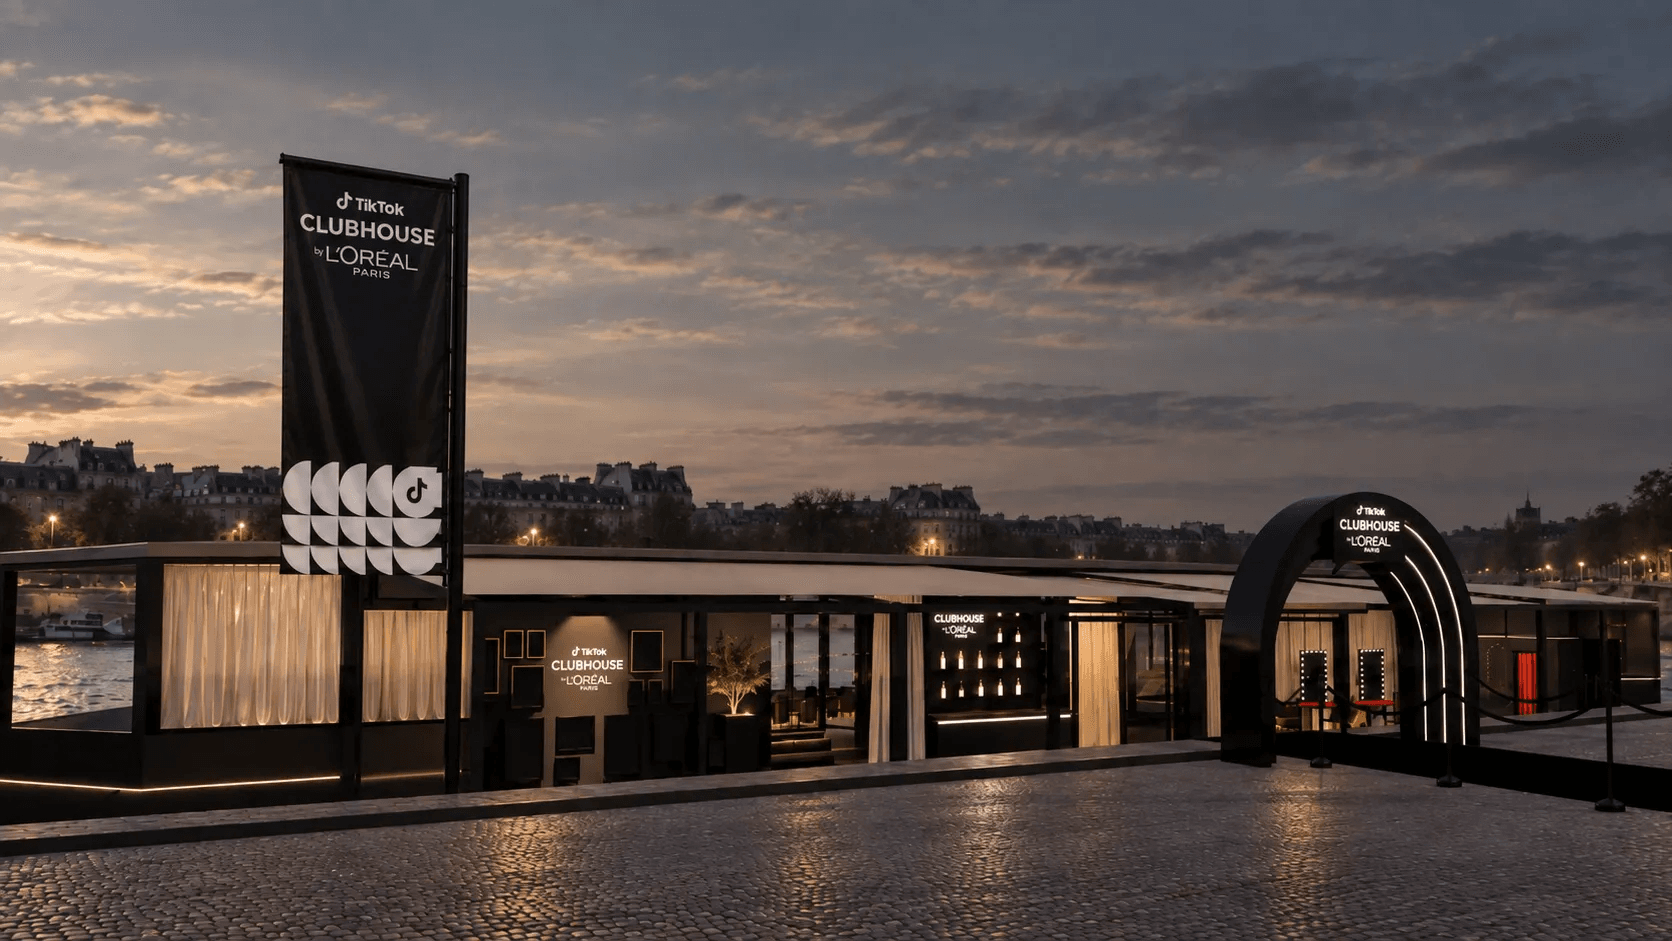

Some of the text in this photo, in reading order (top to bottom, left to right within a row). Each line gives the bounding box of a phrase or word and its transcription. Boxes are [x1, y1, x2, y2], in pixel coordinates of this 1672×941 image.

[355, 197, 404, 216] TikTok
[300, 213, 435, 246] CLUBHOUSE
[313, 245, 418, 271] by L'ORÉAL
[353, 267, 390, 279] PARIS
[1364, 507, 1386, 516] TikTok
[1340, 518, 1400, 532] CLUBHOUSE
[934, 614, 984, 623] CLUBHOUSE
[581, 648, 607, 656] TikTok
[551, 660, 624, 671] CLUBHOUSE
